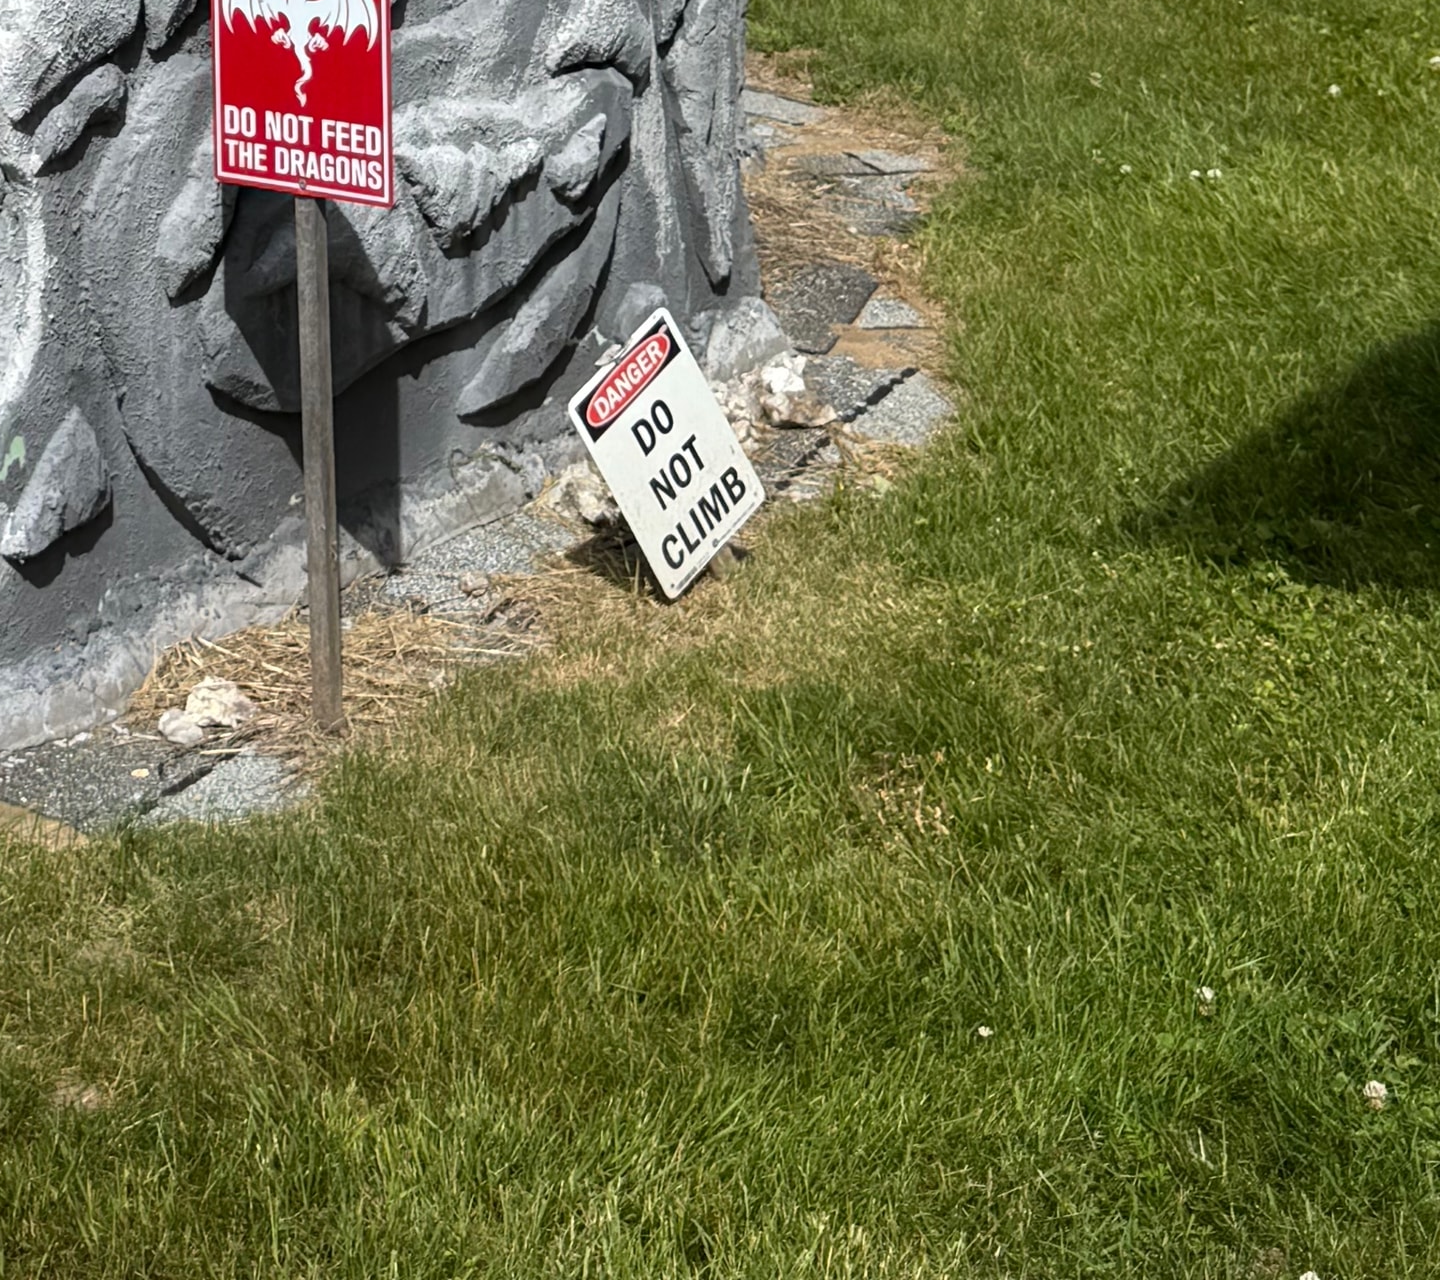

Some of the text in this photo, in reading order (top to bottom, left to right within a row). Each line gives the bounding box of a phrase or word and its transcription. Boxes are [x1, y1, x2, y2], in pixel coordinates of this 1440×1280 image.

[224, 104, 382, 157] DO NOT FEED
[224, 138, 383, 190] THE DRAGONS
[593, 338, 664, 420] DANGER
[631, 399, 674, 457] DO
[649, 434, 705, 511] NOT
[661, 466, 747, 570] CLIMB
